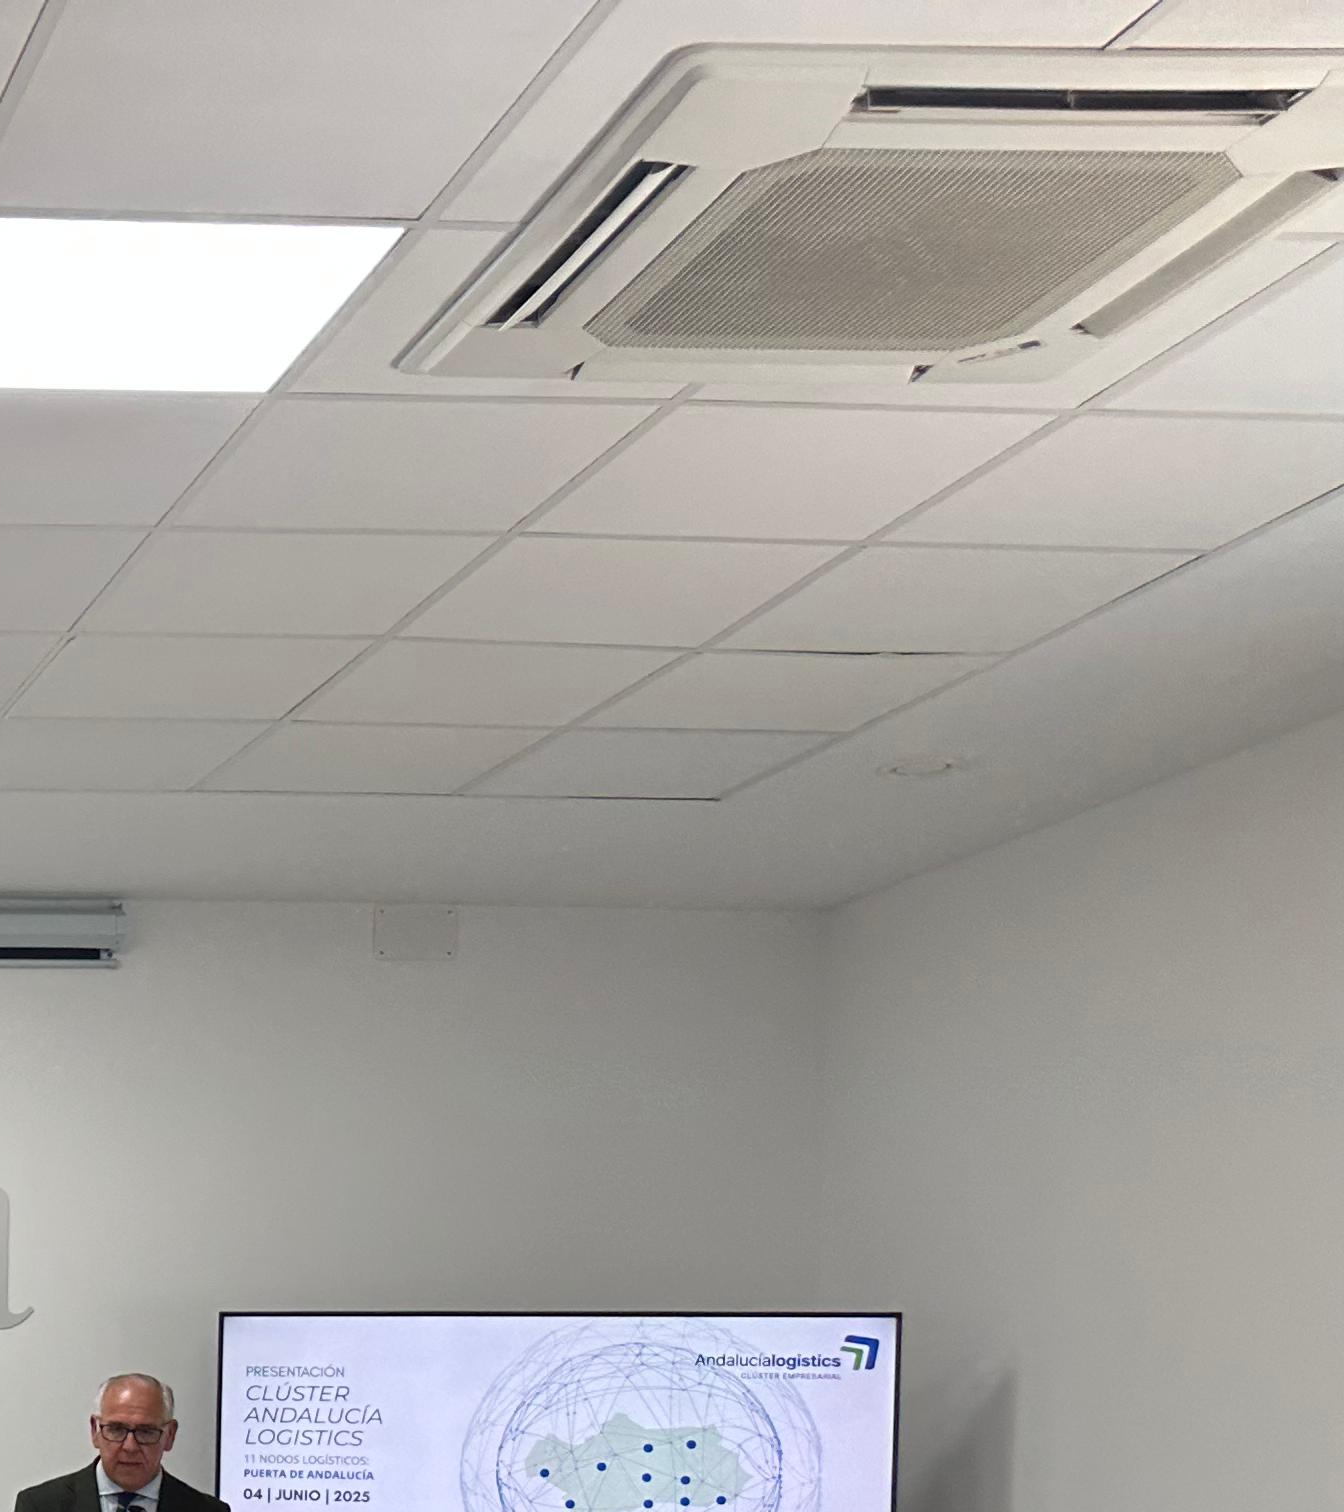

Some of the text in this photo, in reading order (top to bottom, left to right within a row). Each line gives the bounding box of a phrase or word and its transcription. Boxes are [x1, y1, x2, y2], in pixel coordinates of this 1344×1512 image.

[246, 1364, 345, 1378] PRESENTACIÓN
[246, 1382, 350, 1402] CLÚSTER
[243, 1404, 383, 1424] ANDALUCÍA
[245, 1428, 364, 1446] LOGISTICS
[244, 1453, 255, 1463] 11
[259, 1454, 300, 1465] NODOS
[243, 1468, 374, 1481] PUERTA DE ANDALUCÍA
[243, 1488, 263, 1500] 04
[275, 1489, 321, 1501] JUNIO
[334, 1490, 370, 1503] 2025
